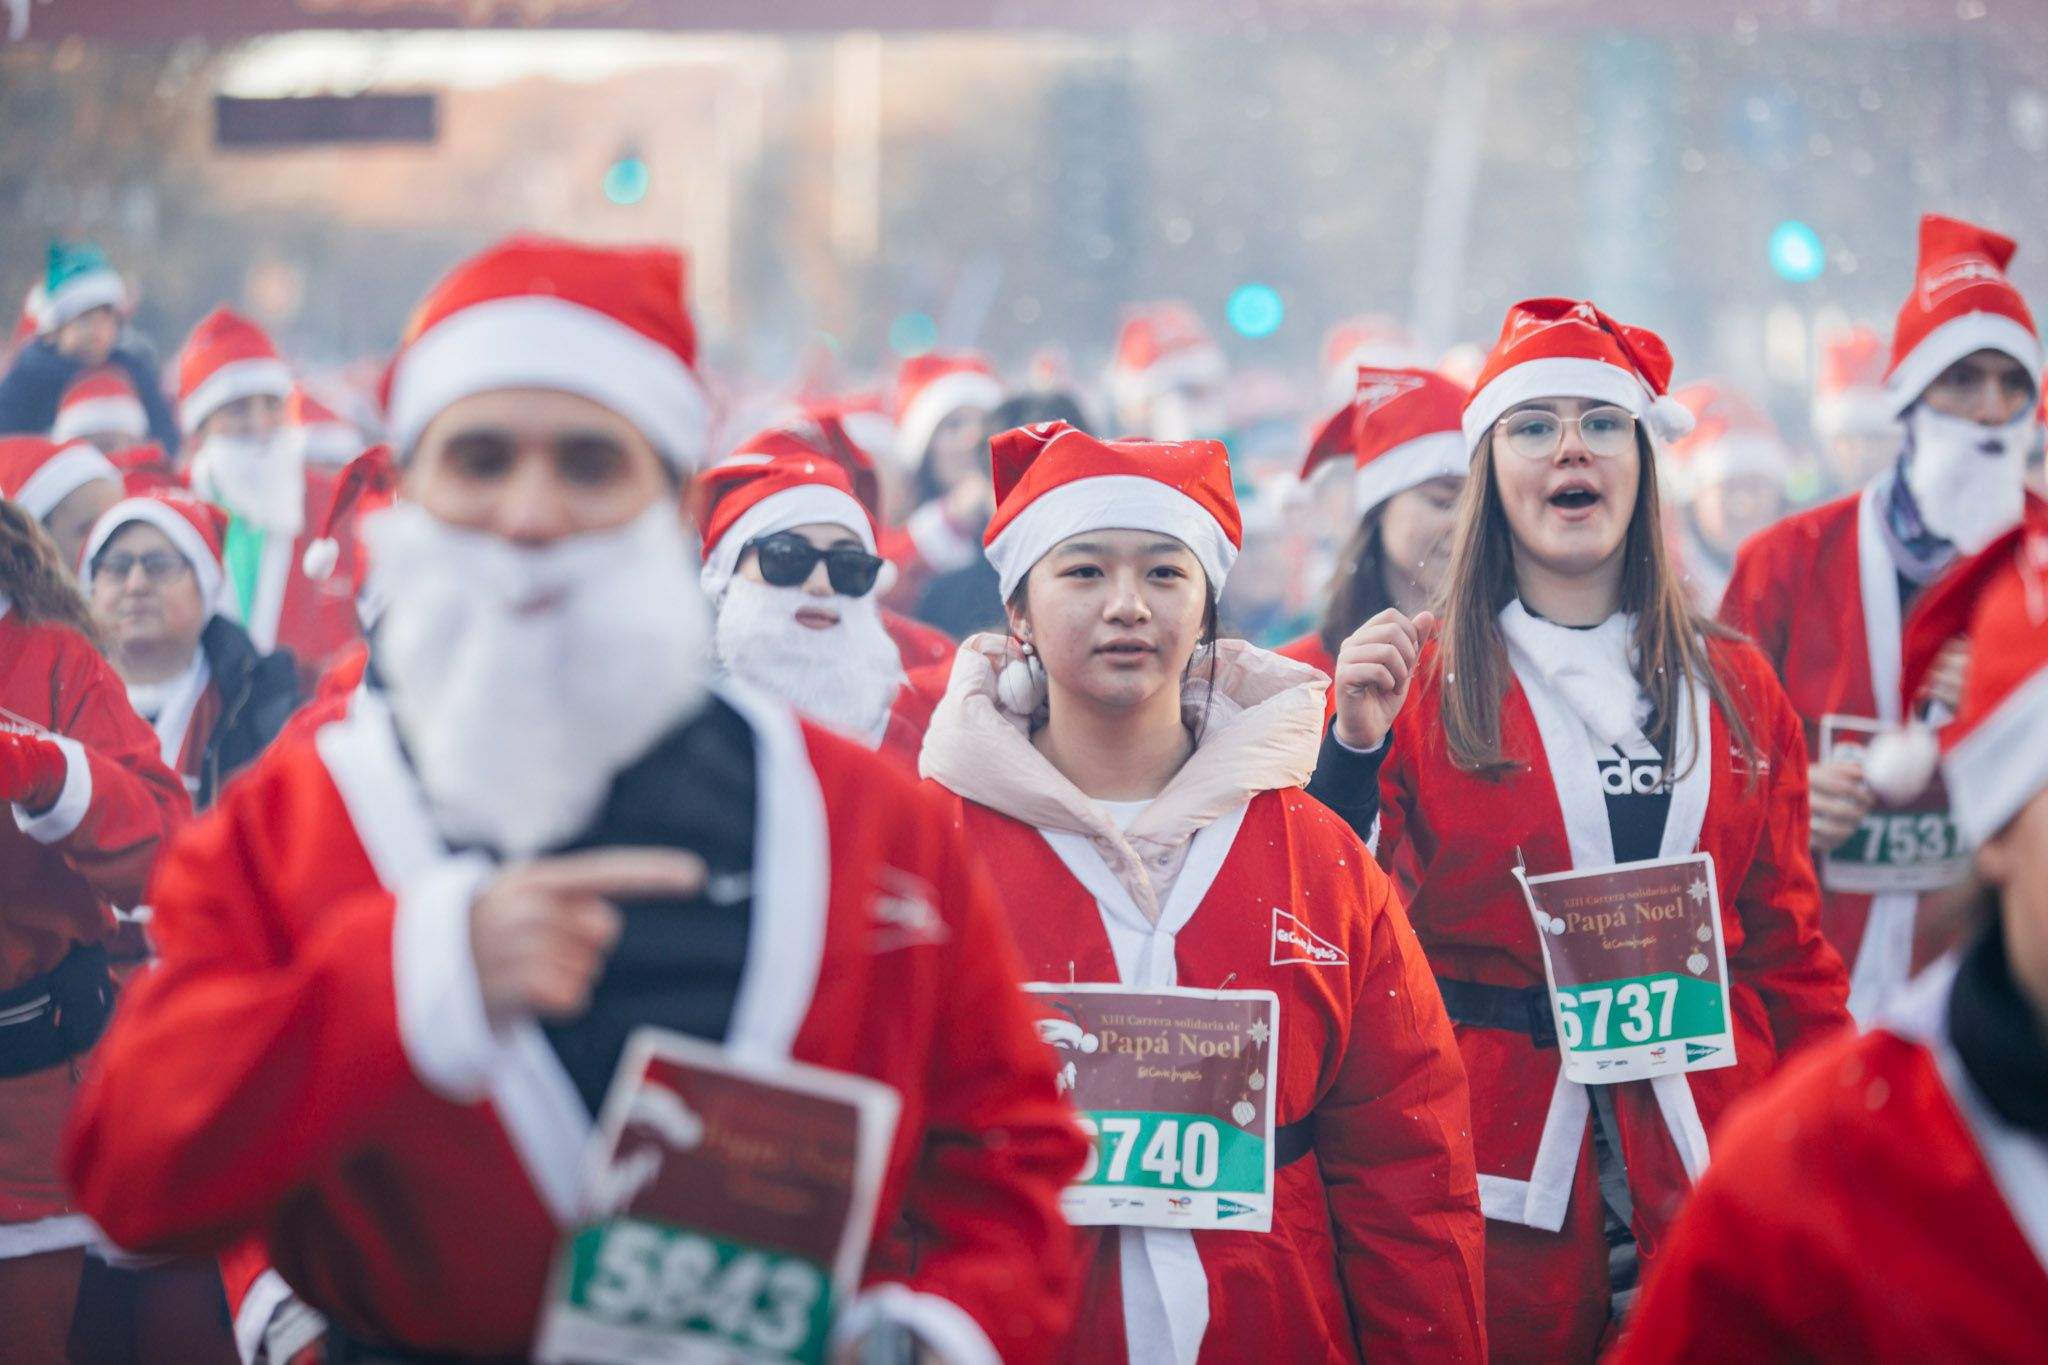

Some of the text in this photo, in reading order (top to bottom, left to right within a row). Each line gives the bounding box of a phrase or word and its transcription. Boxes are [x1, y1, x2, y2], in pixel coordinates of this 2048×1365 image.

[1566, 896, 1685, 936] Papá Noel
[1174, 1017, 1223, 1031] solidaria
[1226, 1020, 1240, 1032] de
[1556, 977, 1680, 1049] 6737
[1100, 1029, 1241, 1061] Papá Noel
